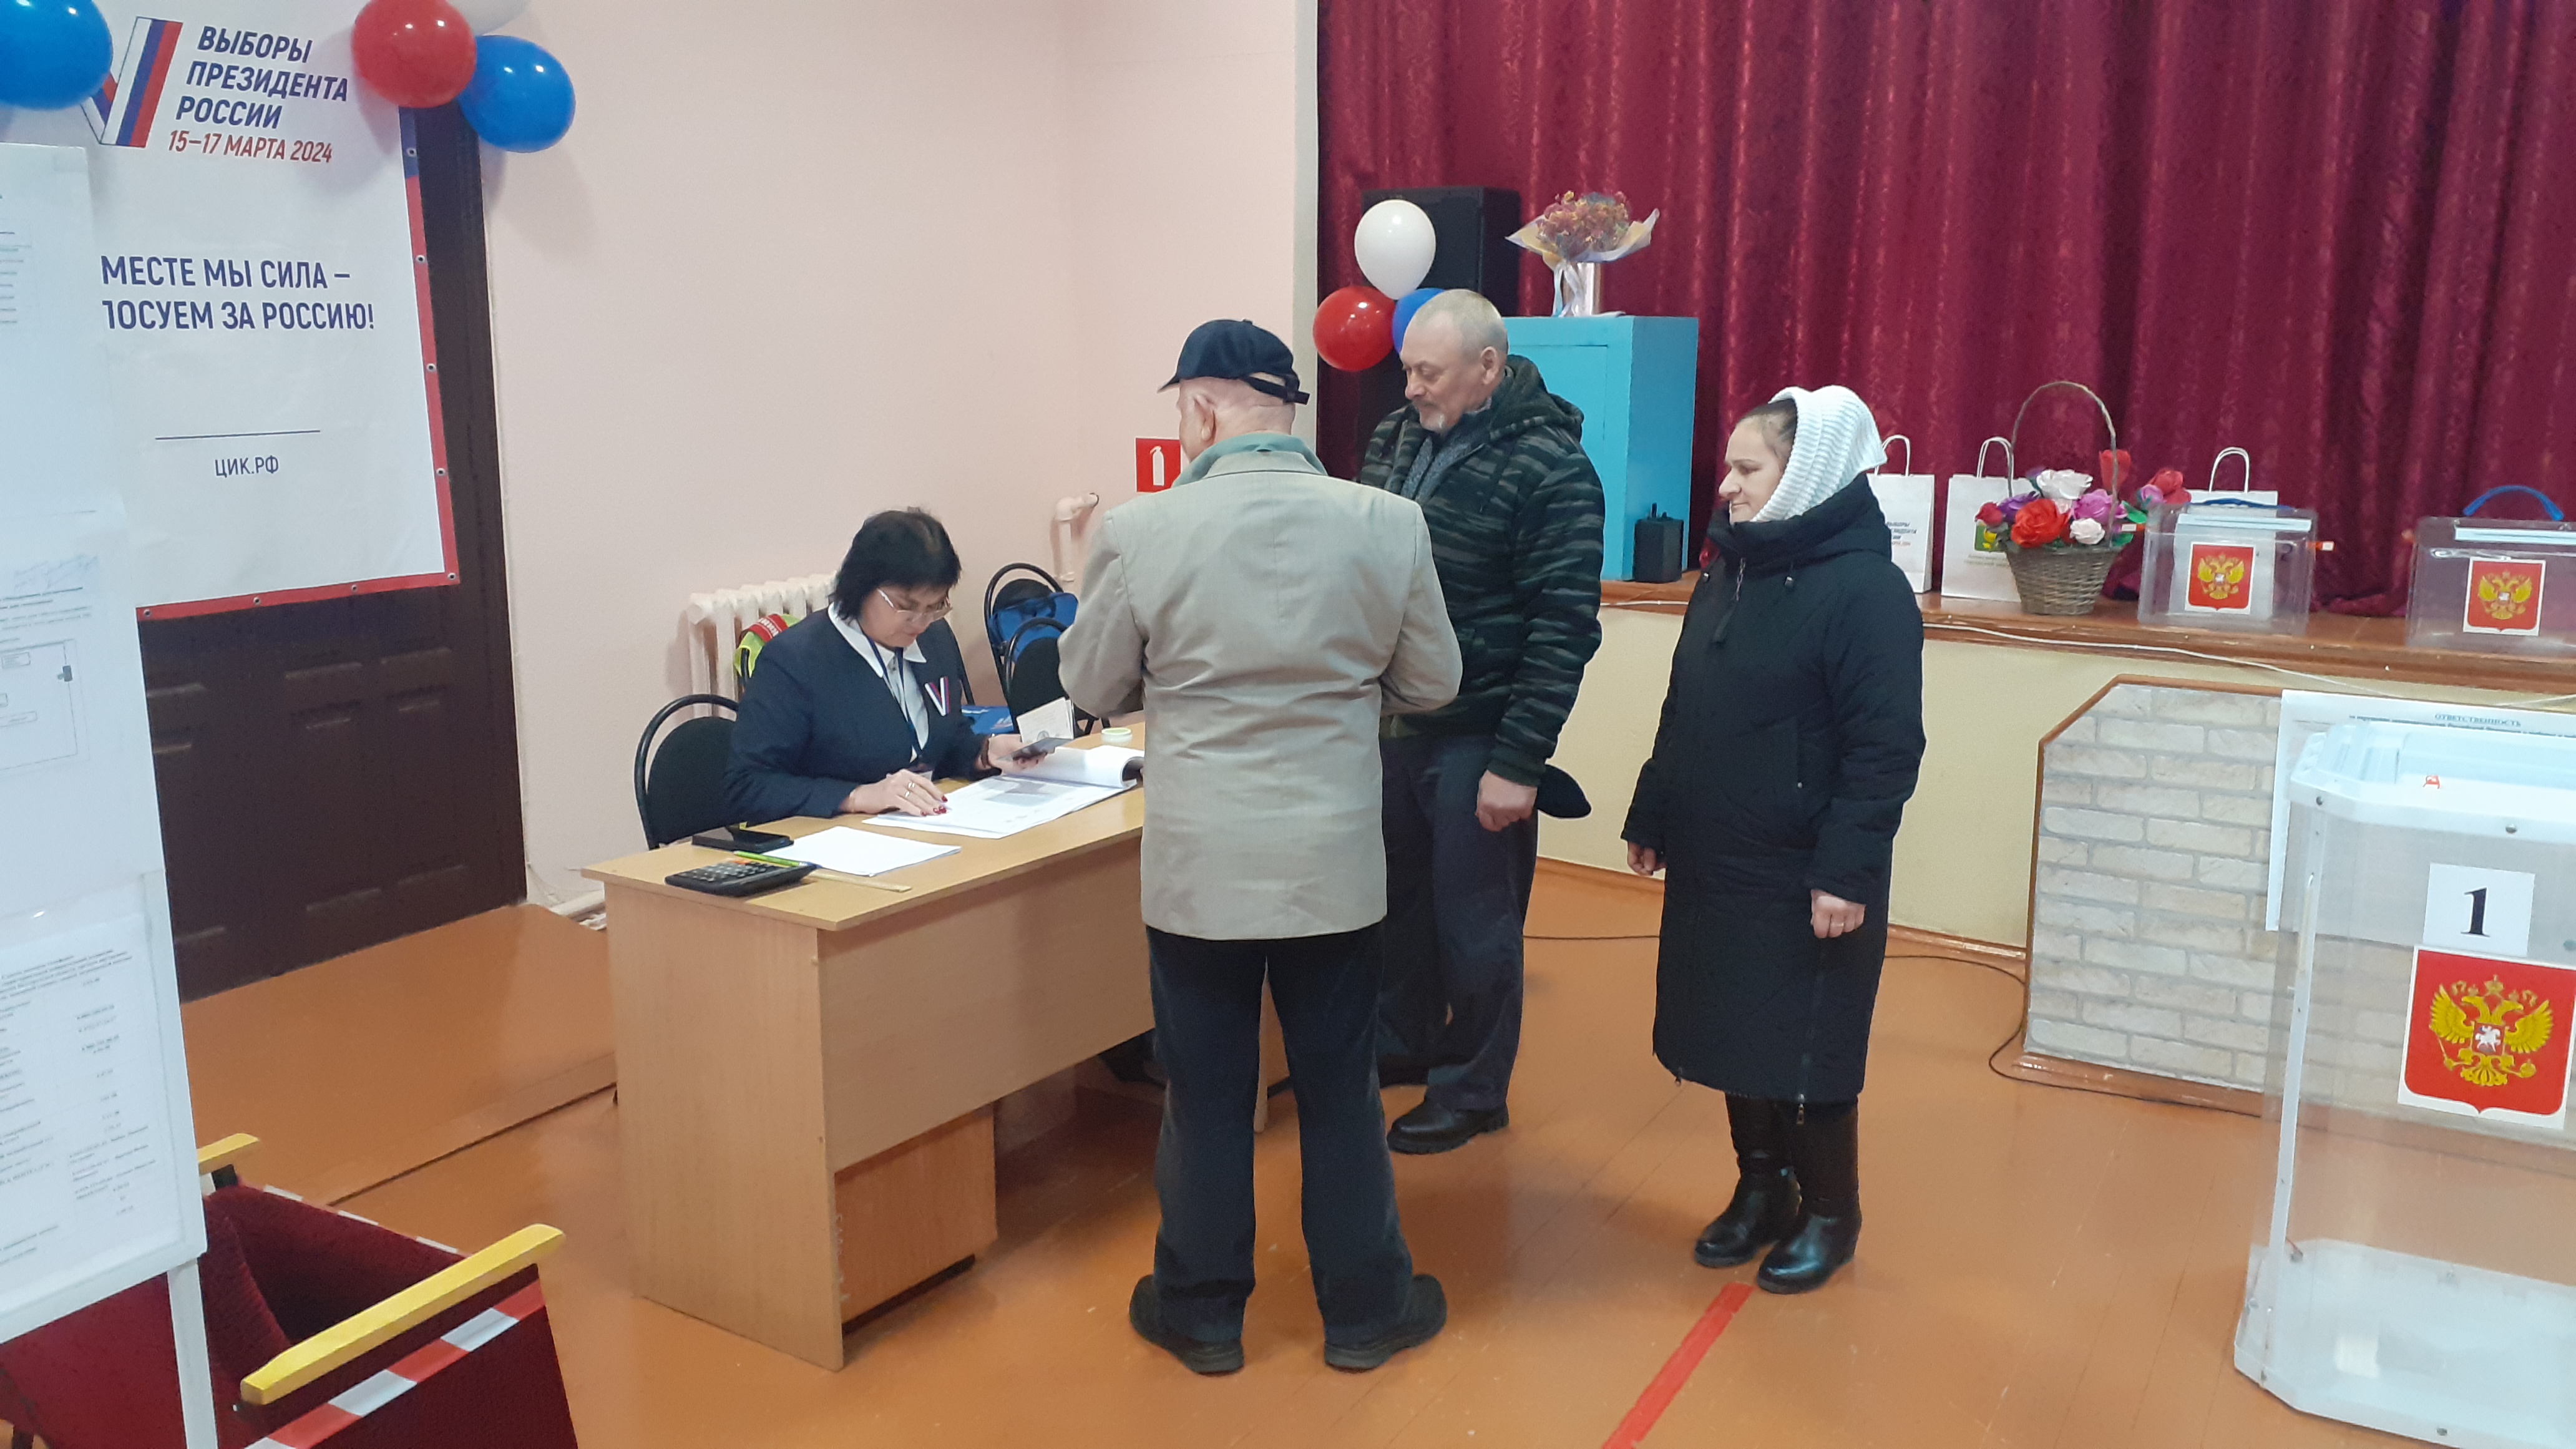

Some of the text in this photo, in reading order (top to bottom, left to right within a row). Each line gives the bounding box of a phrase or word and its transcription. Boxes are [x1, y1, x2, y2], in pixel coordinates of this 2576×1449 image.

[197, 26, 313, 64] ВЫБОРЫ
[186, 61, 349, 102] ПРЕЗИДЕНТА
[175, 96, 283, 129] РОССИИ
[223, 135, 285, 160] МАРТА
[290, 140, 333, 163] 2024
[100, 255, 196, 286] МЕСТЕ
[203, 258, 252, 288] МЫ
[260, 260, 328, 289] СИЛА
[221, 301, 256, 329] ЗА
[261, 302, 374, 329] РОССИЮ!
[215, 455, 279, 479] ЦИК.РФ
[2461, 887, 2490, 937] 1
